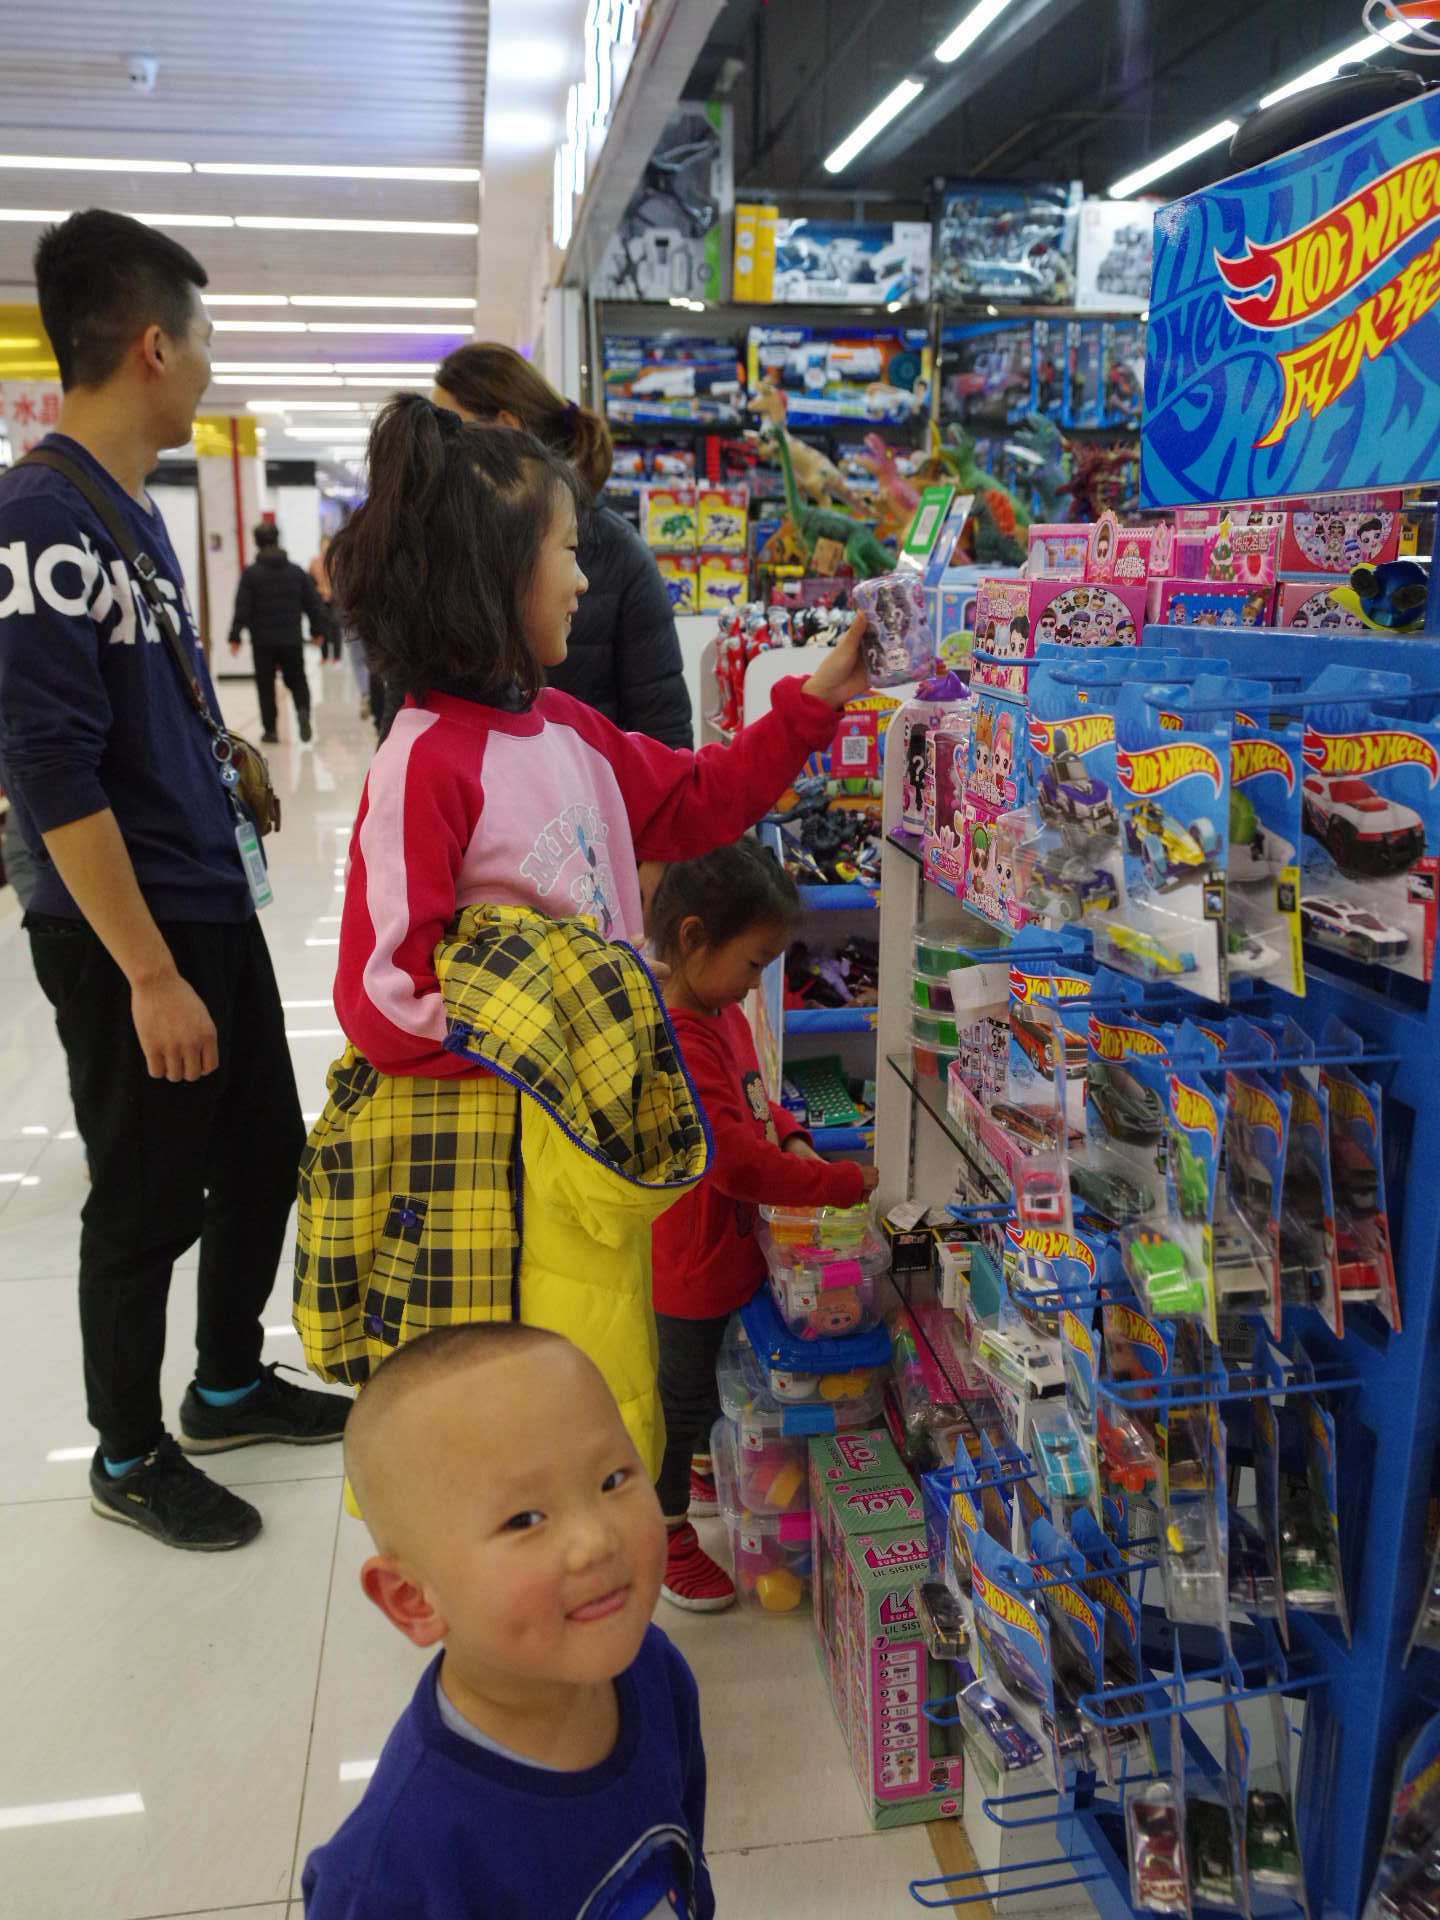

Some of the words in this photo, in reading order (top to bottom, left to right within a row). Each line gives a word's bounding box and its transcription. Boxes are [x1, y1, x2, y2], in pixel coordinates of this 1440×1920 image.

[1268, 226, 1349, 321] HOT
[1340, 158, 1440, 287] WHE
[1321, 737, 1362, 772] HOT
[1360, 734, 1433, 772] WHEELS
[1044, 1231, 1092, 1265] WHELS
[889, 1562, 928, 1575] SISTERS
[901, 1621, 920, 1632] SIST
[876, 1636, 885, 1648] 7
